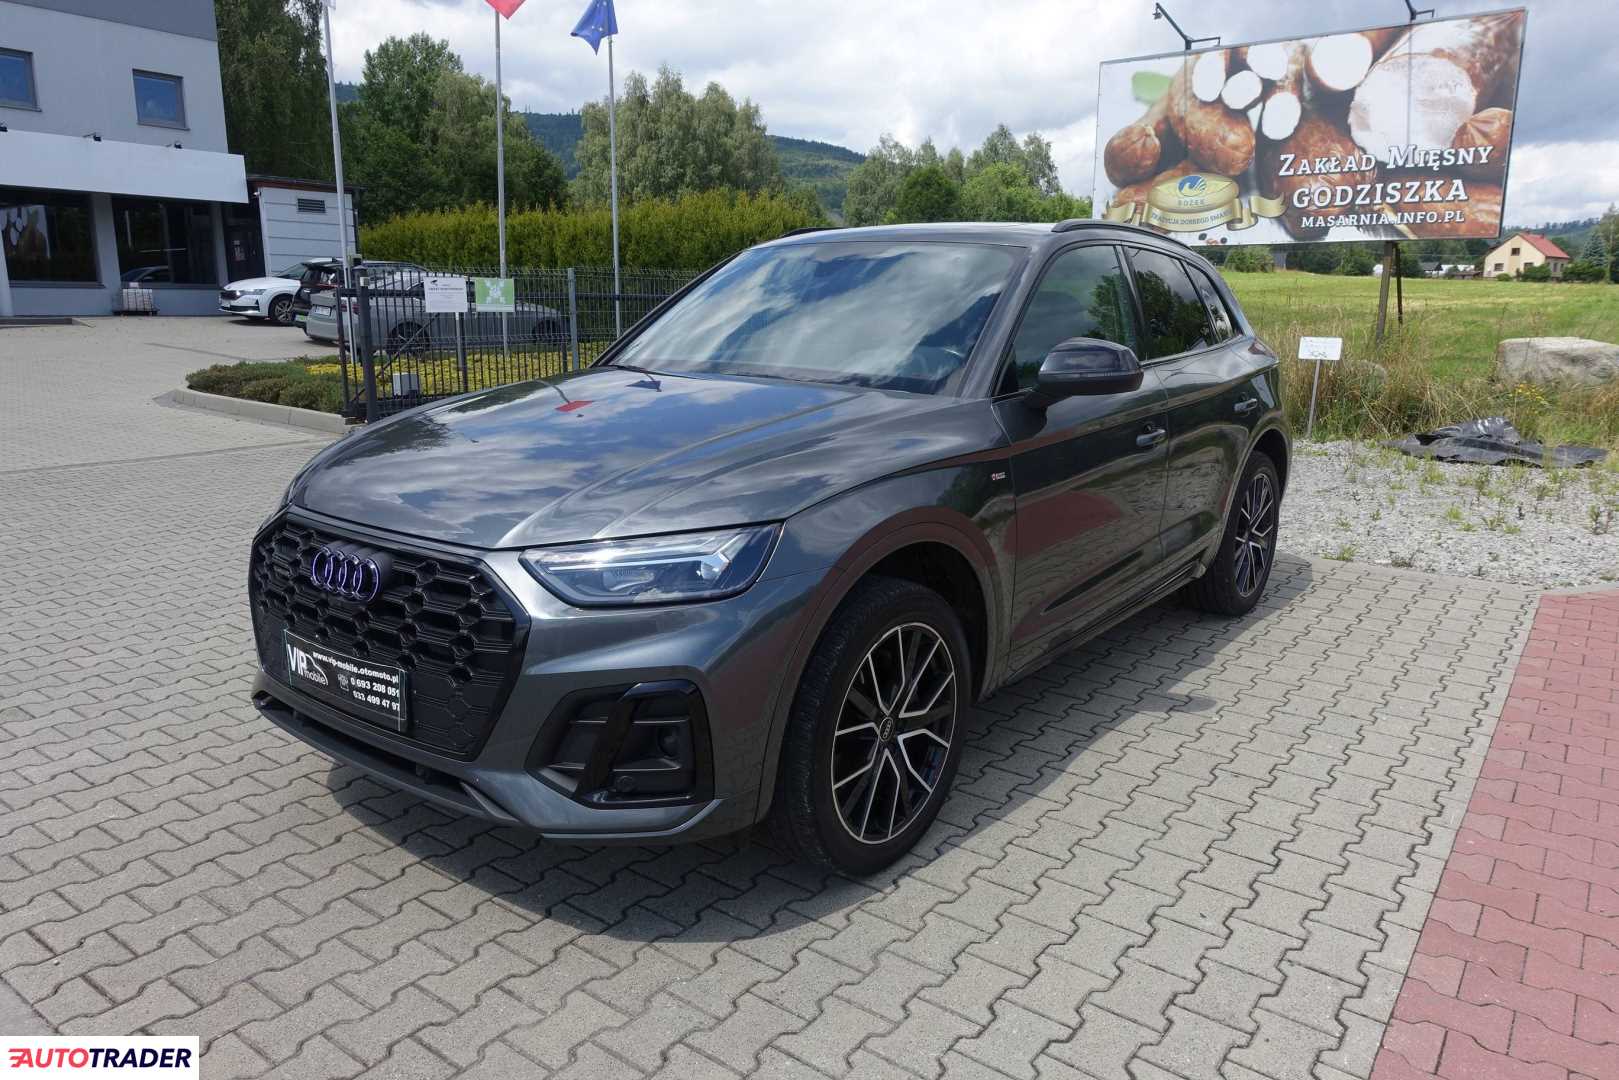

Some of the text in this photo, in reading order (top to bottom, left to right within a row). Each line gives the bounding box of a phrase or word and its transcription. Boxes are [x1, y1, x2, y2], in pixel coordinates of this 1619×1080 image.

[1279, 144, 1493, 176] ZAKŁAD MIĘSNY
[1293, 179, 1468, 208] GODZISZKA
[1301, 210, 1465, 228] MASARNIA.INFO.PL
[287, 643, 307, 676] VIP
